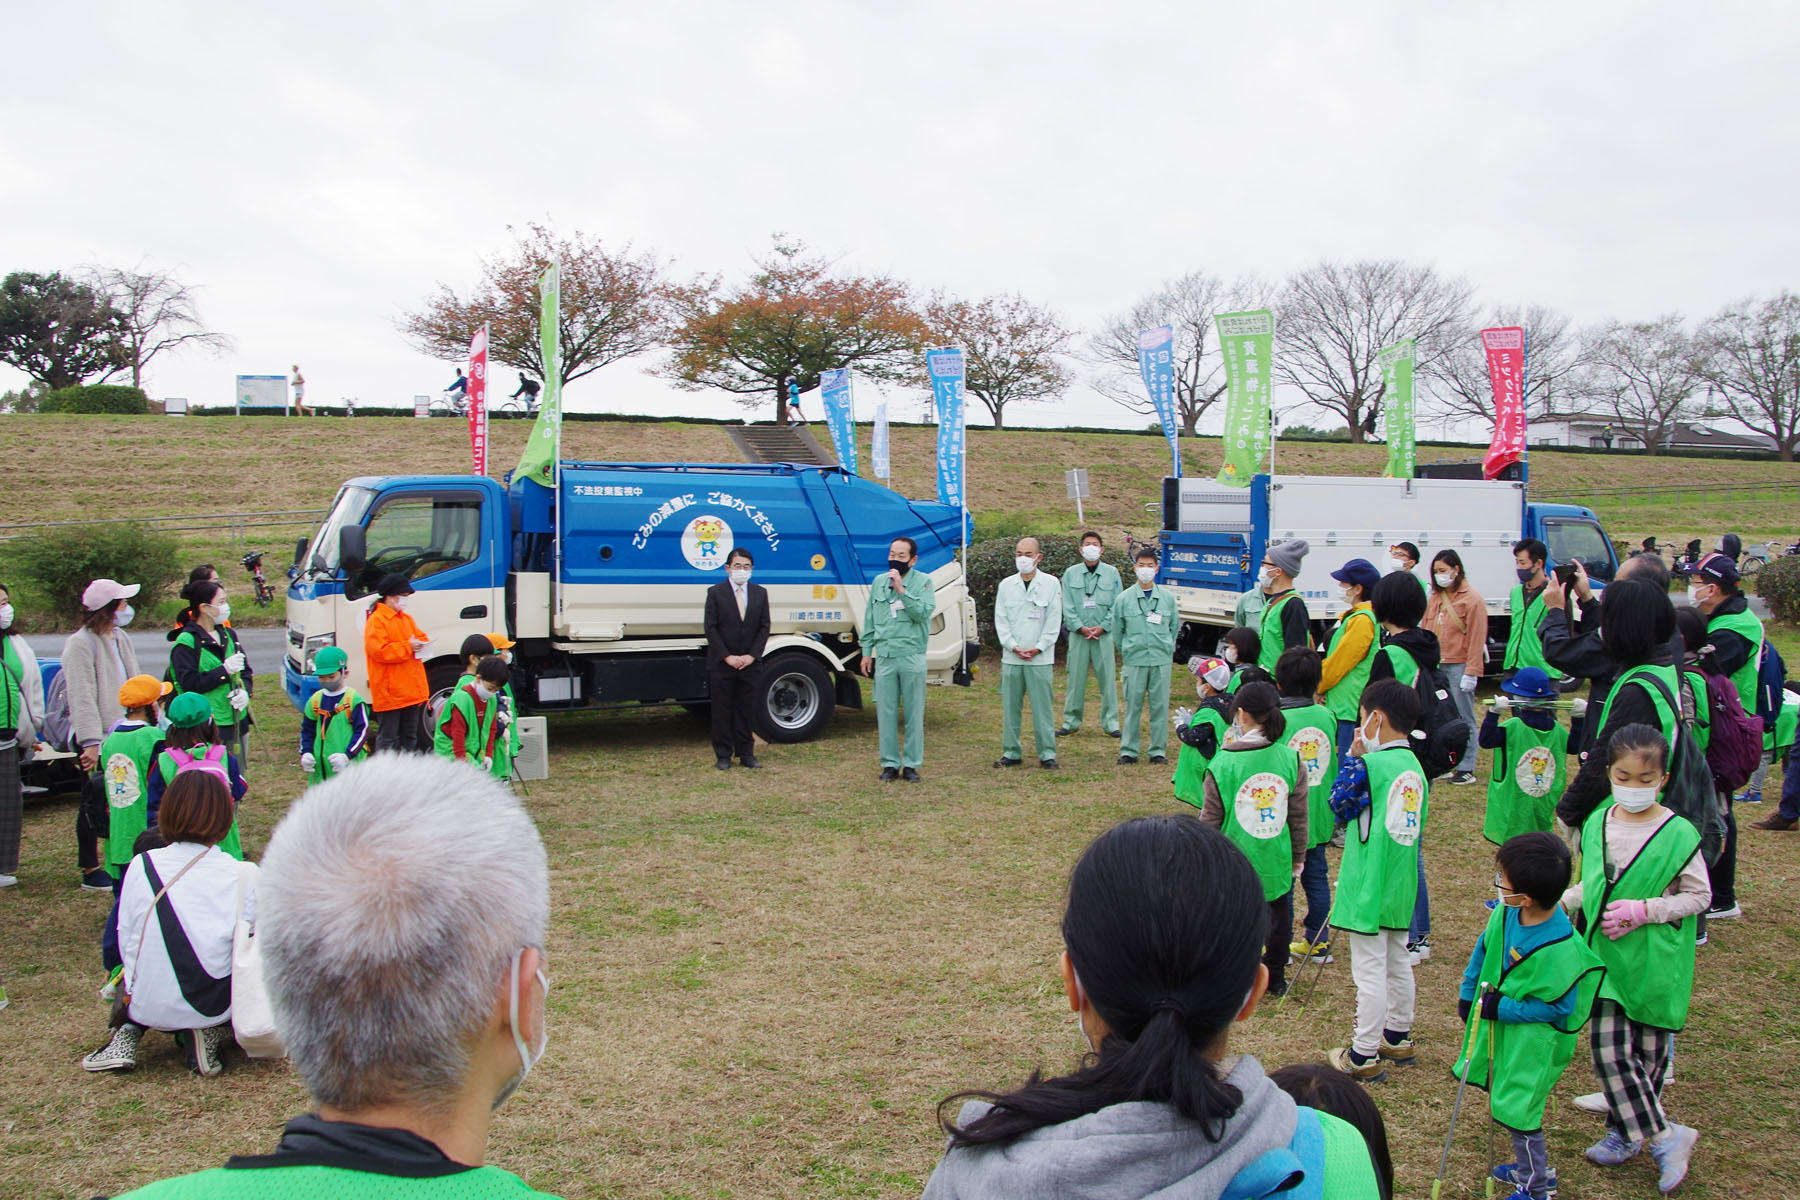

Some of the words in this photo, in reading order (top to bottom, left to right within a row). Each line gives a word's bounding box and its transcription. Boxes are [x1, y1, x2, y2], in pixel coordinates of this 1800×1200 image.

[573, 485, 643, 496] 不法投棄監視中
[632, 493, 697, 549] ごみの減量に
[707, 491, 780, 552] ご協力ください。
[1170, 552, 1199, 562] ごみの減量に
